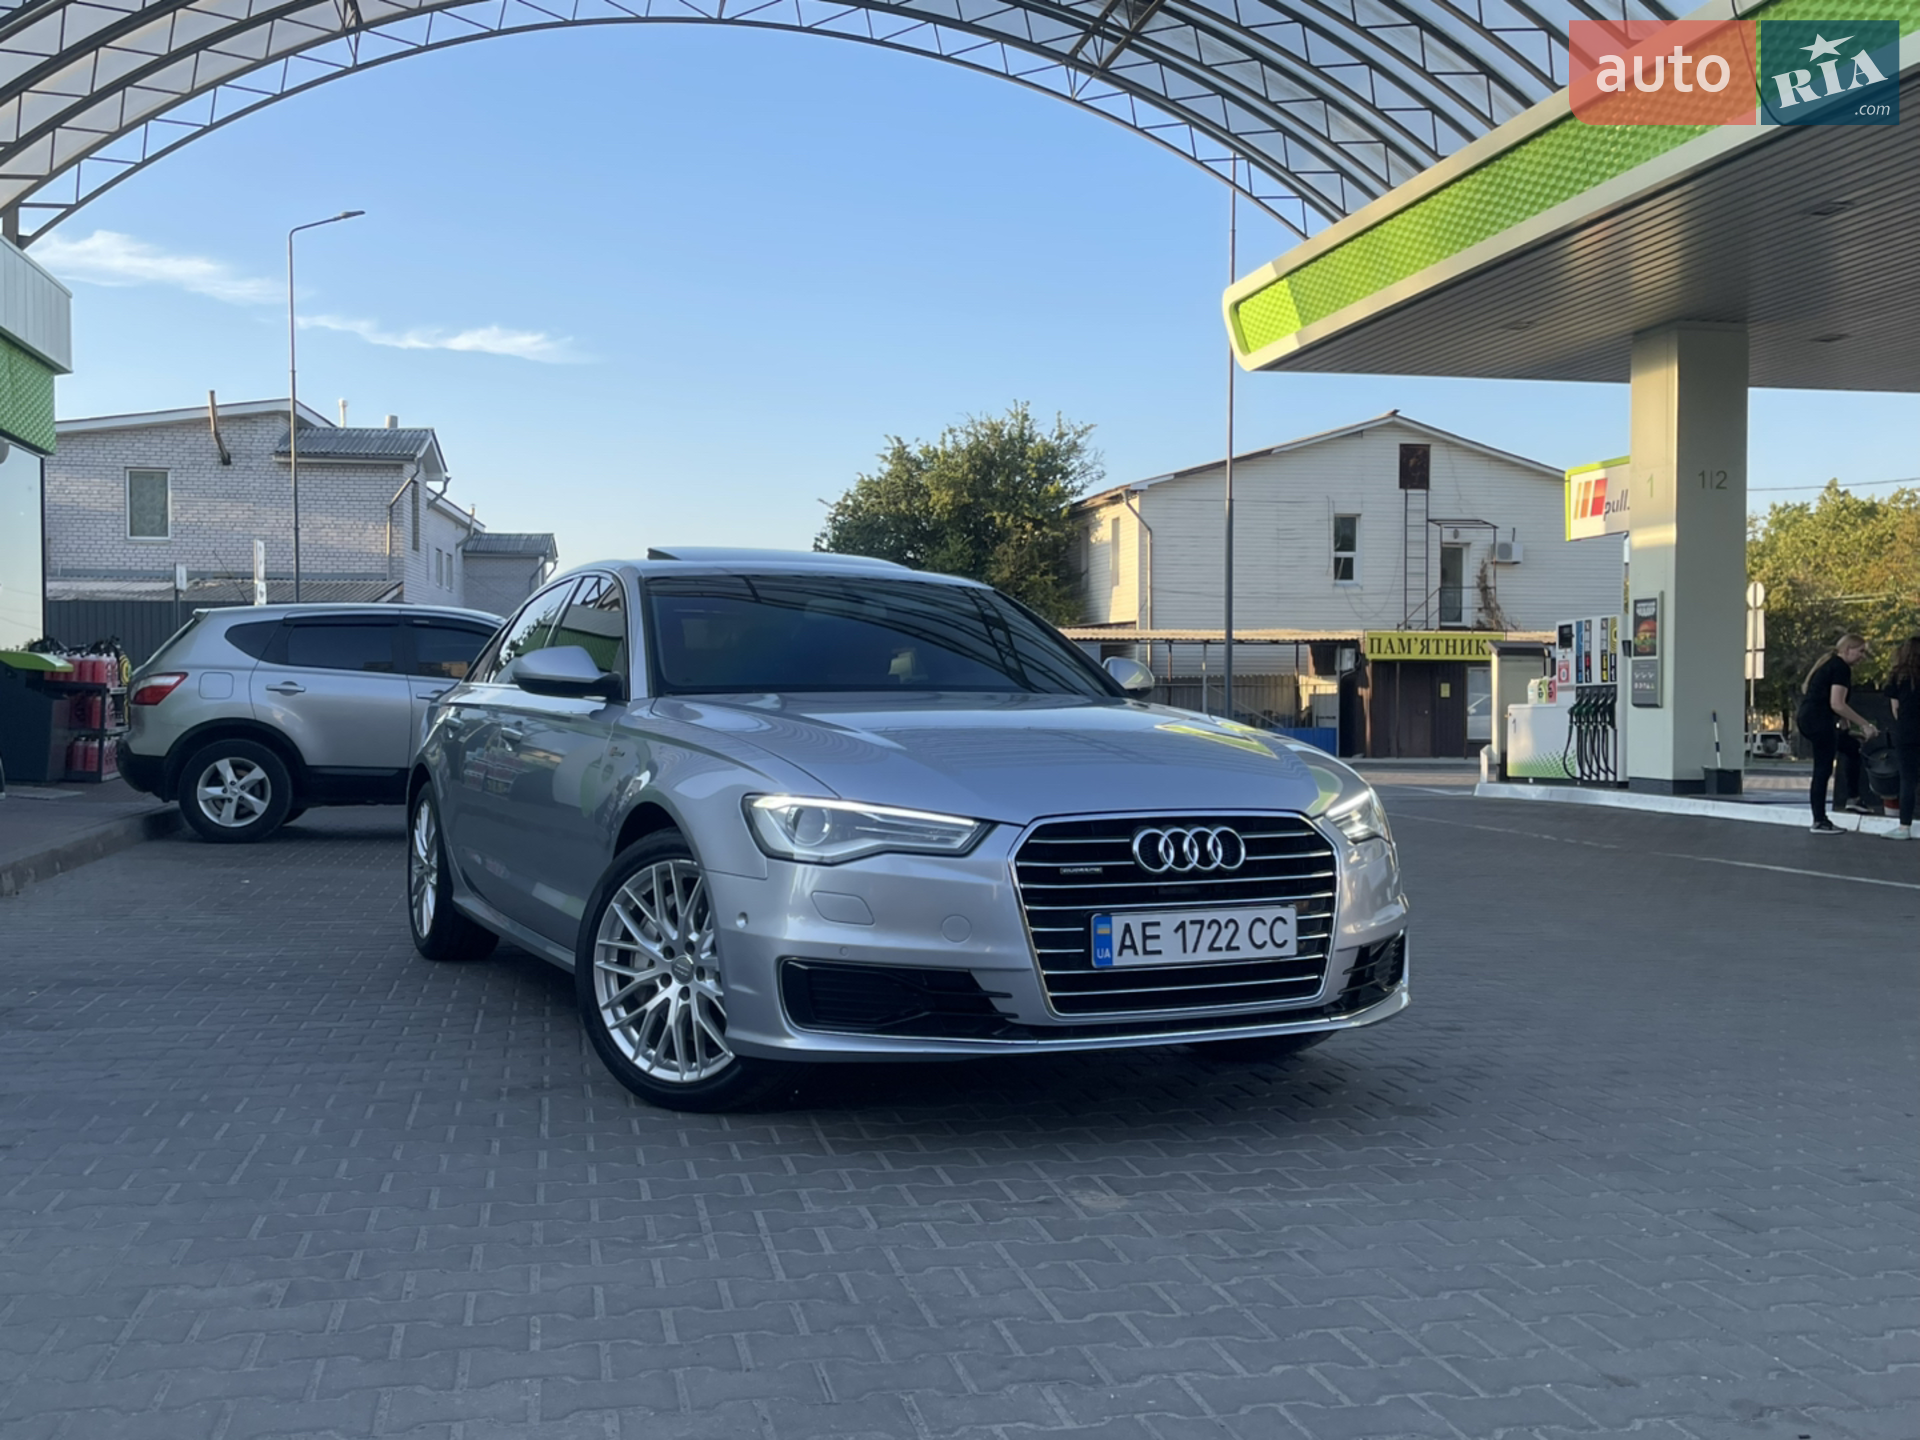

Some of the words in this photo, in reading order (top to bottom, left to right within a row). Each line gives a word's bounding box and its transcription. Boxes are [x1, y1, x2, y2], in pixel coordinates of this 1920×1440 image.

[1646, 473, 1655, 498] 1
[1603, 488, 1630, 521] pull
[1369, 637, 1492, 656] ПАМ'ЯТНИК
[1512, 718, 1517, 734] 1
[1117, 921, 1162, 957] AE
[1173, 918, 1240, 954] 1722
[1248, 916, 1288, 949] CC
[1096, 947, 1111, 959] UA
